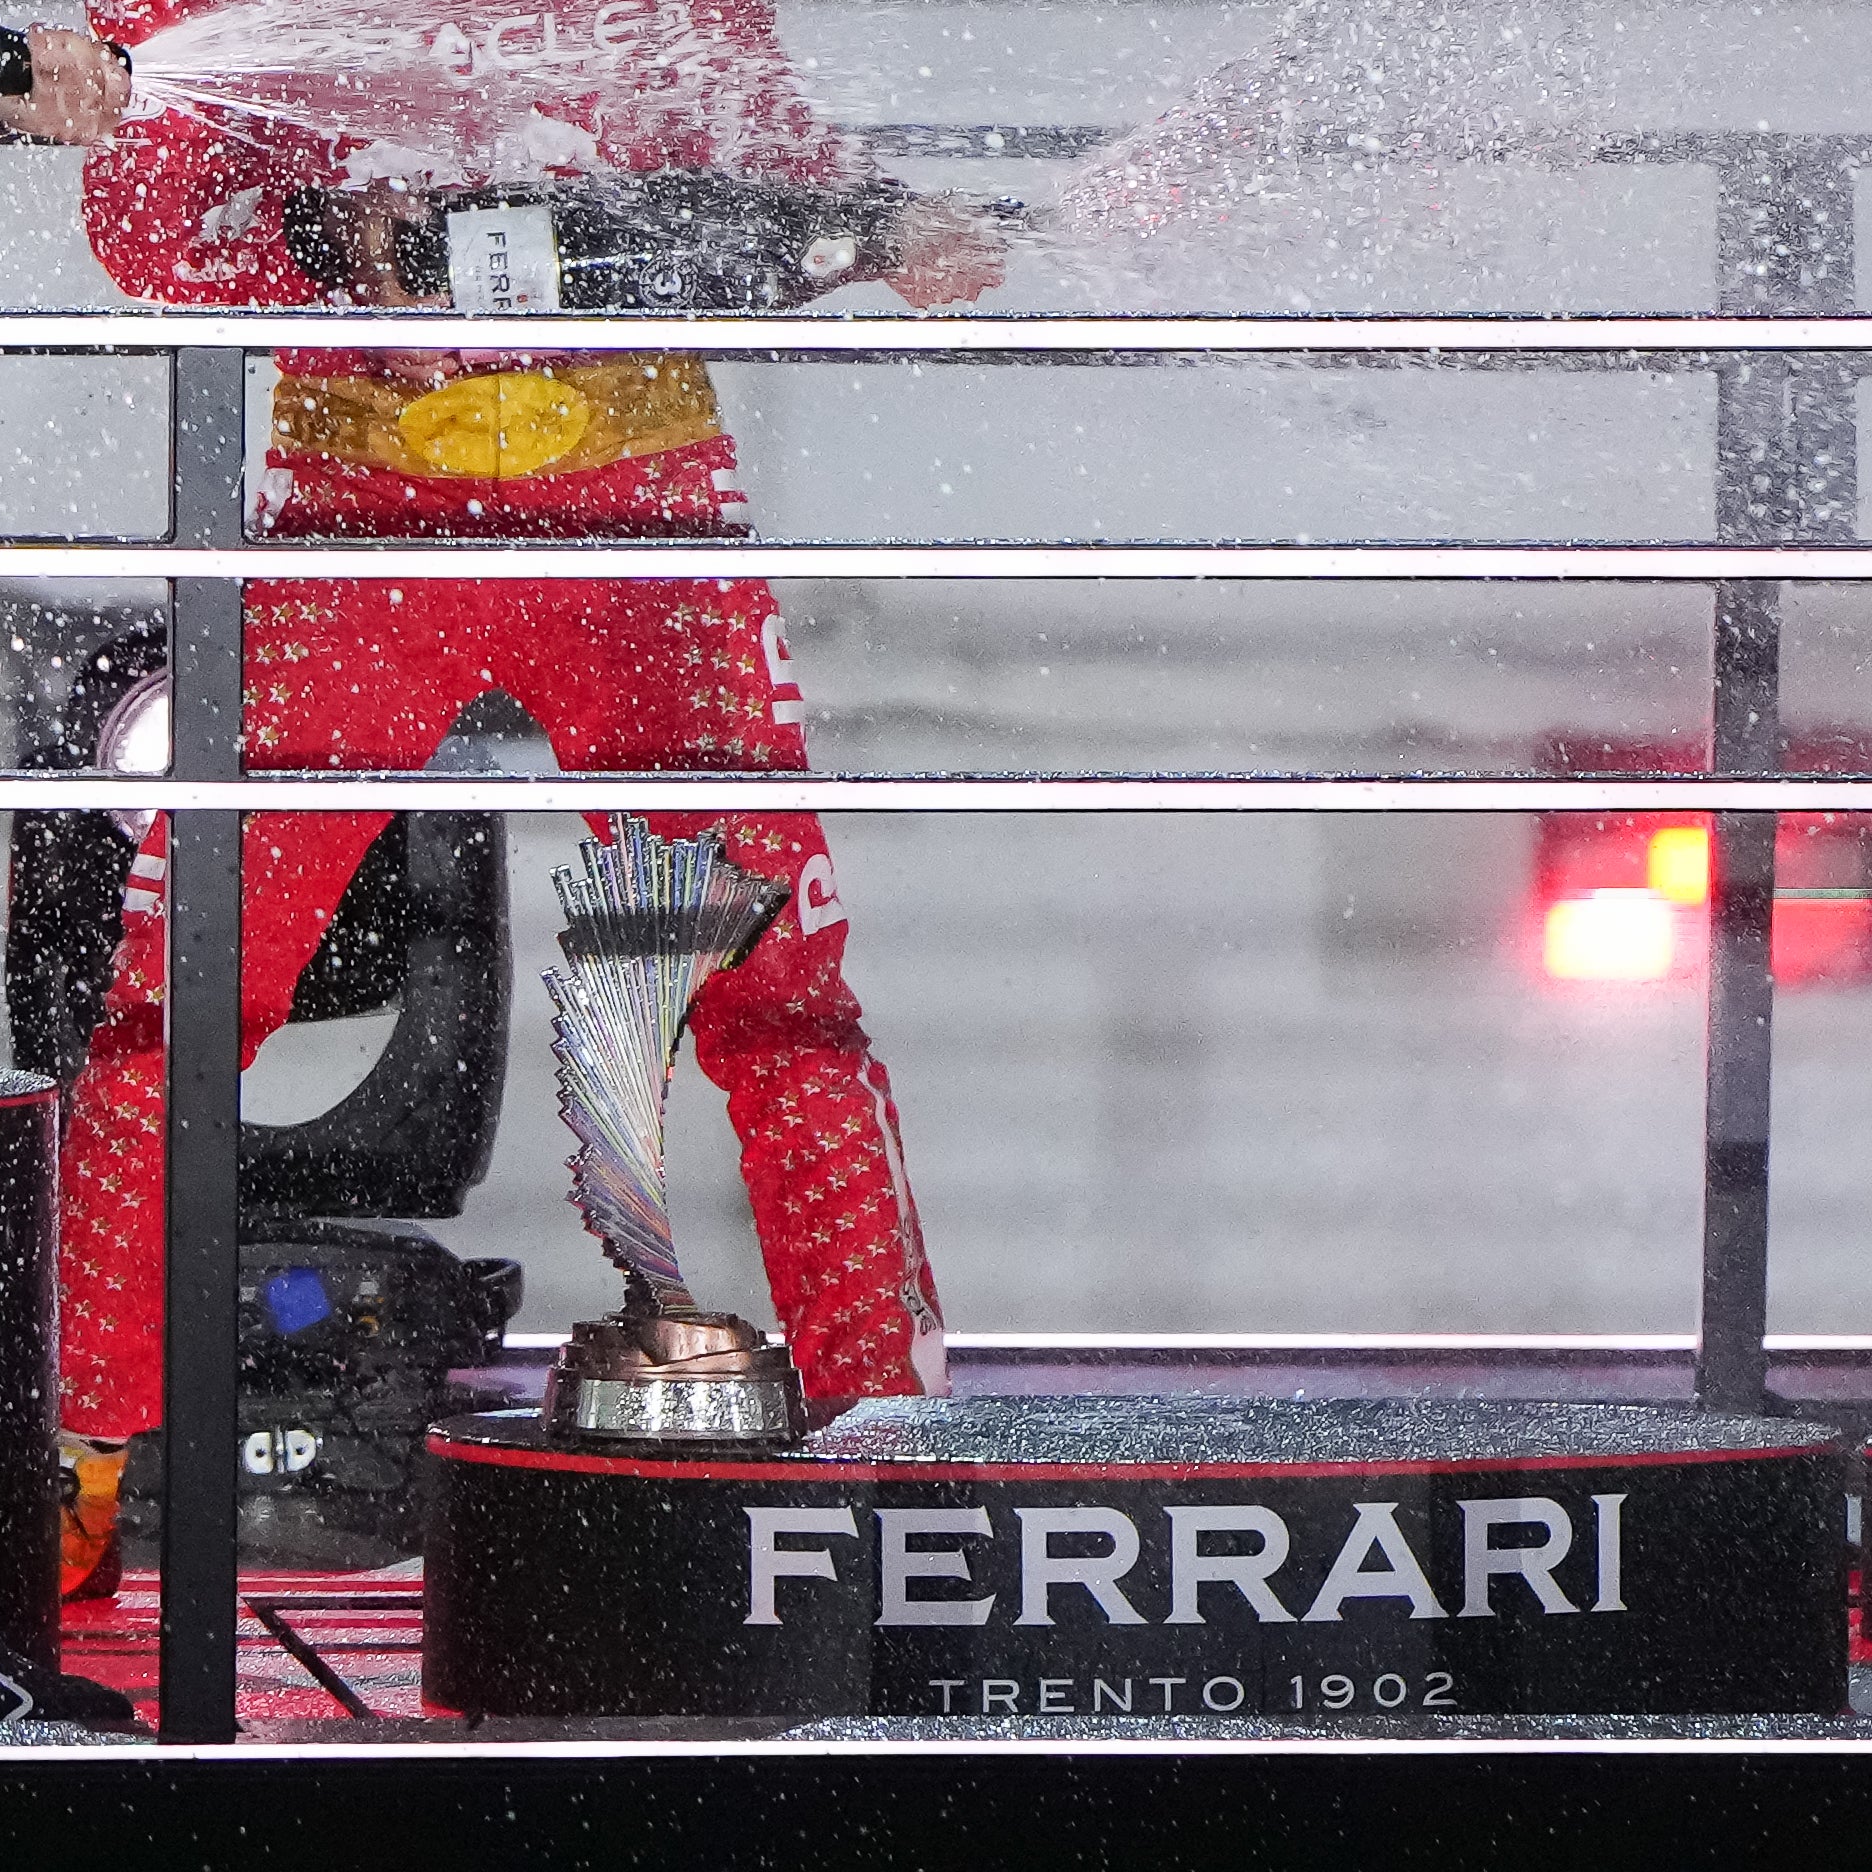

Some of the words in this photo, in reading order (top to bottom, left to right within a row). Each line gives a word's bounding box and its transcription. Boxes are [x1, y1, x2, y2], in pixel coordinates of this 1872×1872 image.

[741, 1492, 1629, 1627] FERRARI
[928, 1674, 1247, 1715] TRENTO
[1290, 1670, 1458, 1710] 1902
